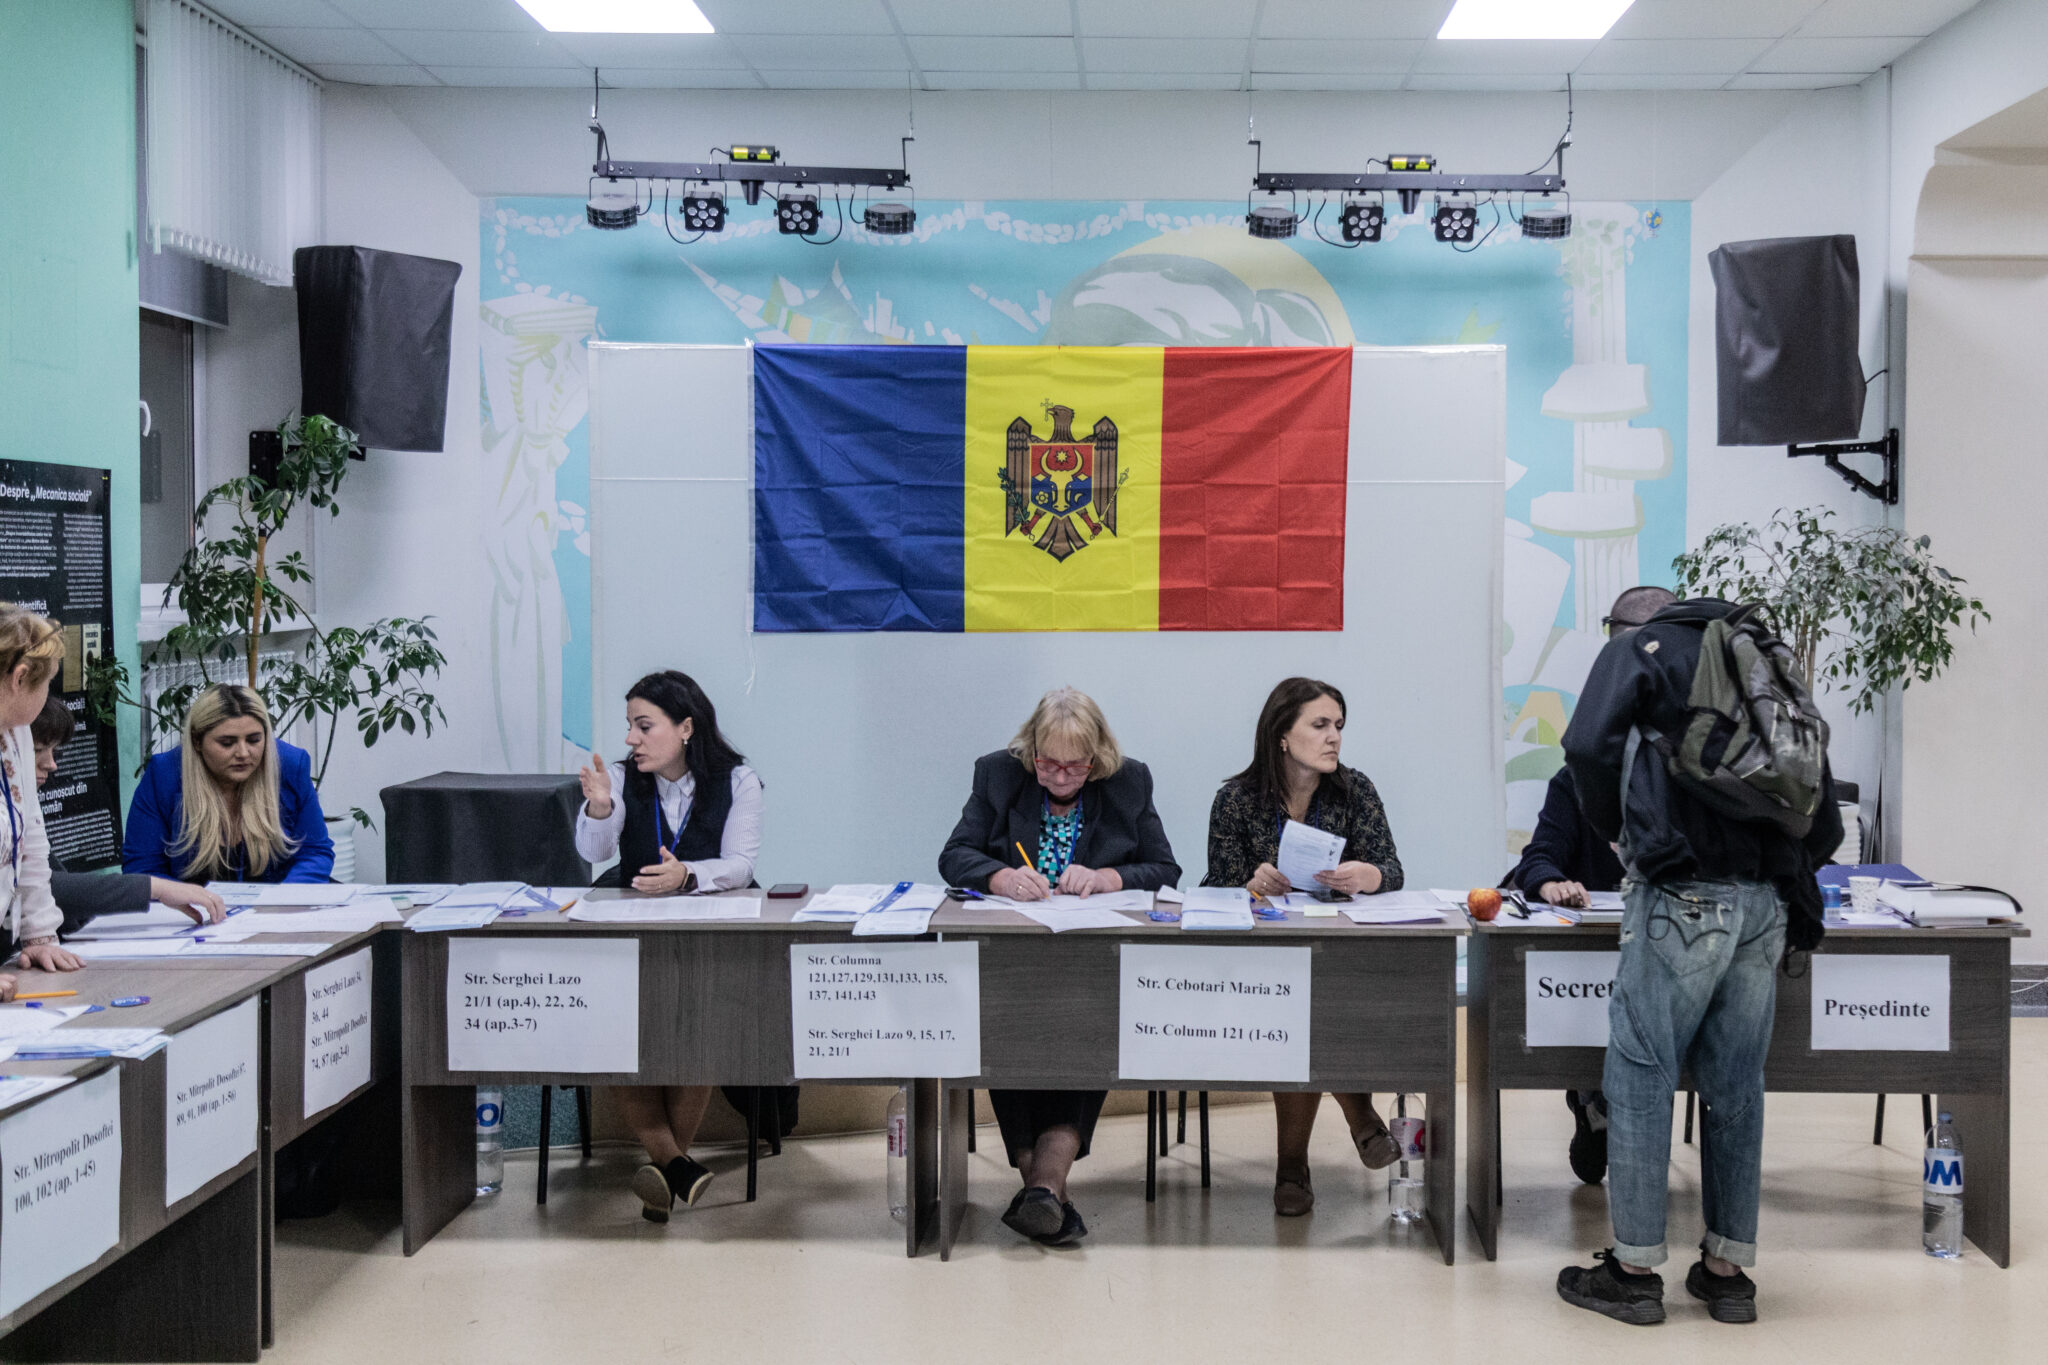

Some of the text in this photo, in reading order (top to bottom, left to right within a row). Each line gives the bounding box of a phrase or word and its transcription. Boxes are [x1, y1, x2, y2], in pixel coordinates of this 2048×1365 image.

[0, 484, 30, 501] Despre
[76, 782, 88, 794] din
[807, 954, 882, 966] Str. Columna
[464, 972, 582, 988] Str. Serghei Lazo
[925, 972, 948, 984] 135,
[312, 987, 322, 1001] Str.
[1136, 976, 1291, 997] Str. Cebotari Maria 28
[809, 989, 877, 1001] 137, 141,143
[464, 995, 588, 1011] 21/1 (ap.4), 22, 26,
[1824, 998, 1931, 1020] Președinte
[464, 1017, 538, 1033] 34 (ap.3-7)
[808, 1028, 956, 1042] Str. Serghei Lazo 9, 15, 17,
[1134, 1022, 1289, 1044] Str. Column 121 (1-63)
[311, 1035, 322, 1049] Str.
[808, 1045, 850, 1057] 21, 21/1
[177, 1091, 187, 1104] Str.
[176, 1112, 186, 1127] 89,
[14, 1120, 113, 1183] Str. Mitropolit Dosoftei
[15, 1159, 96, 1213] 100, 102 (ap. 1-45)
